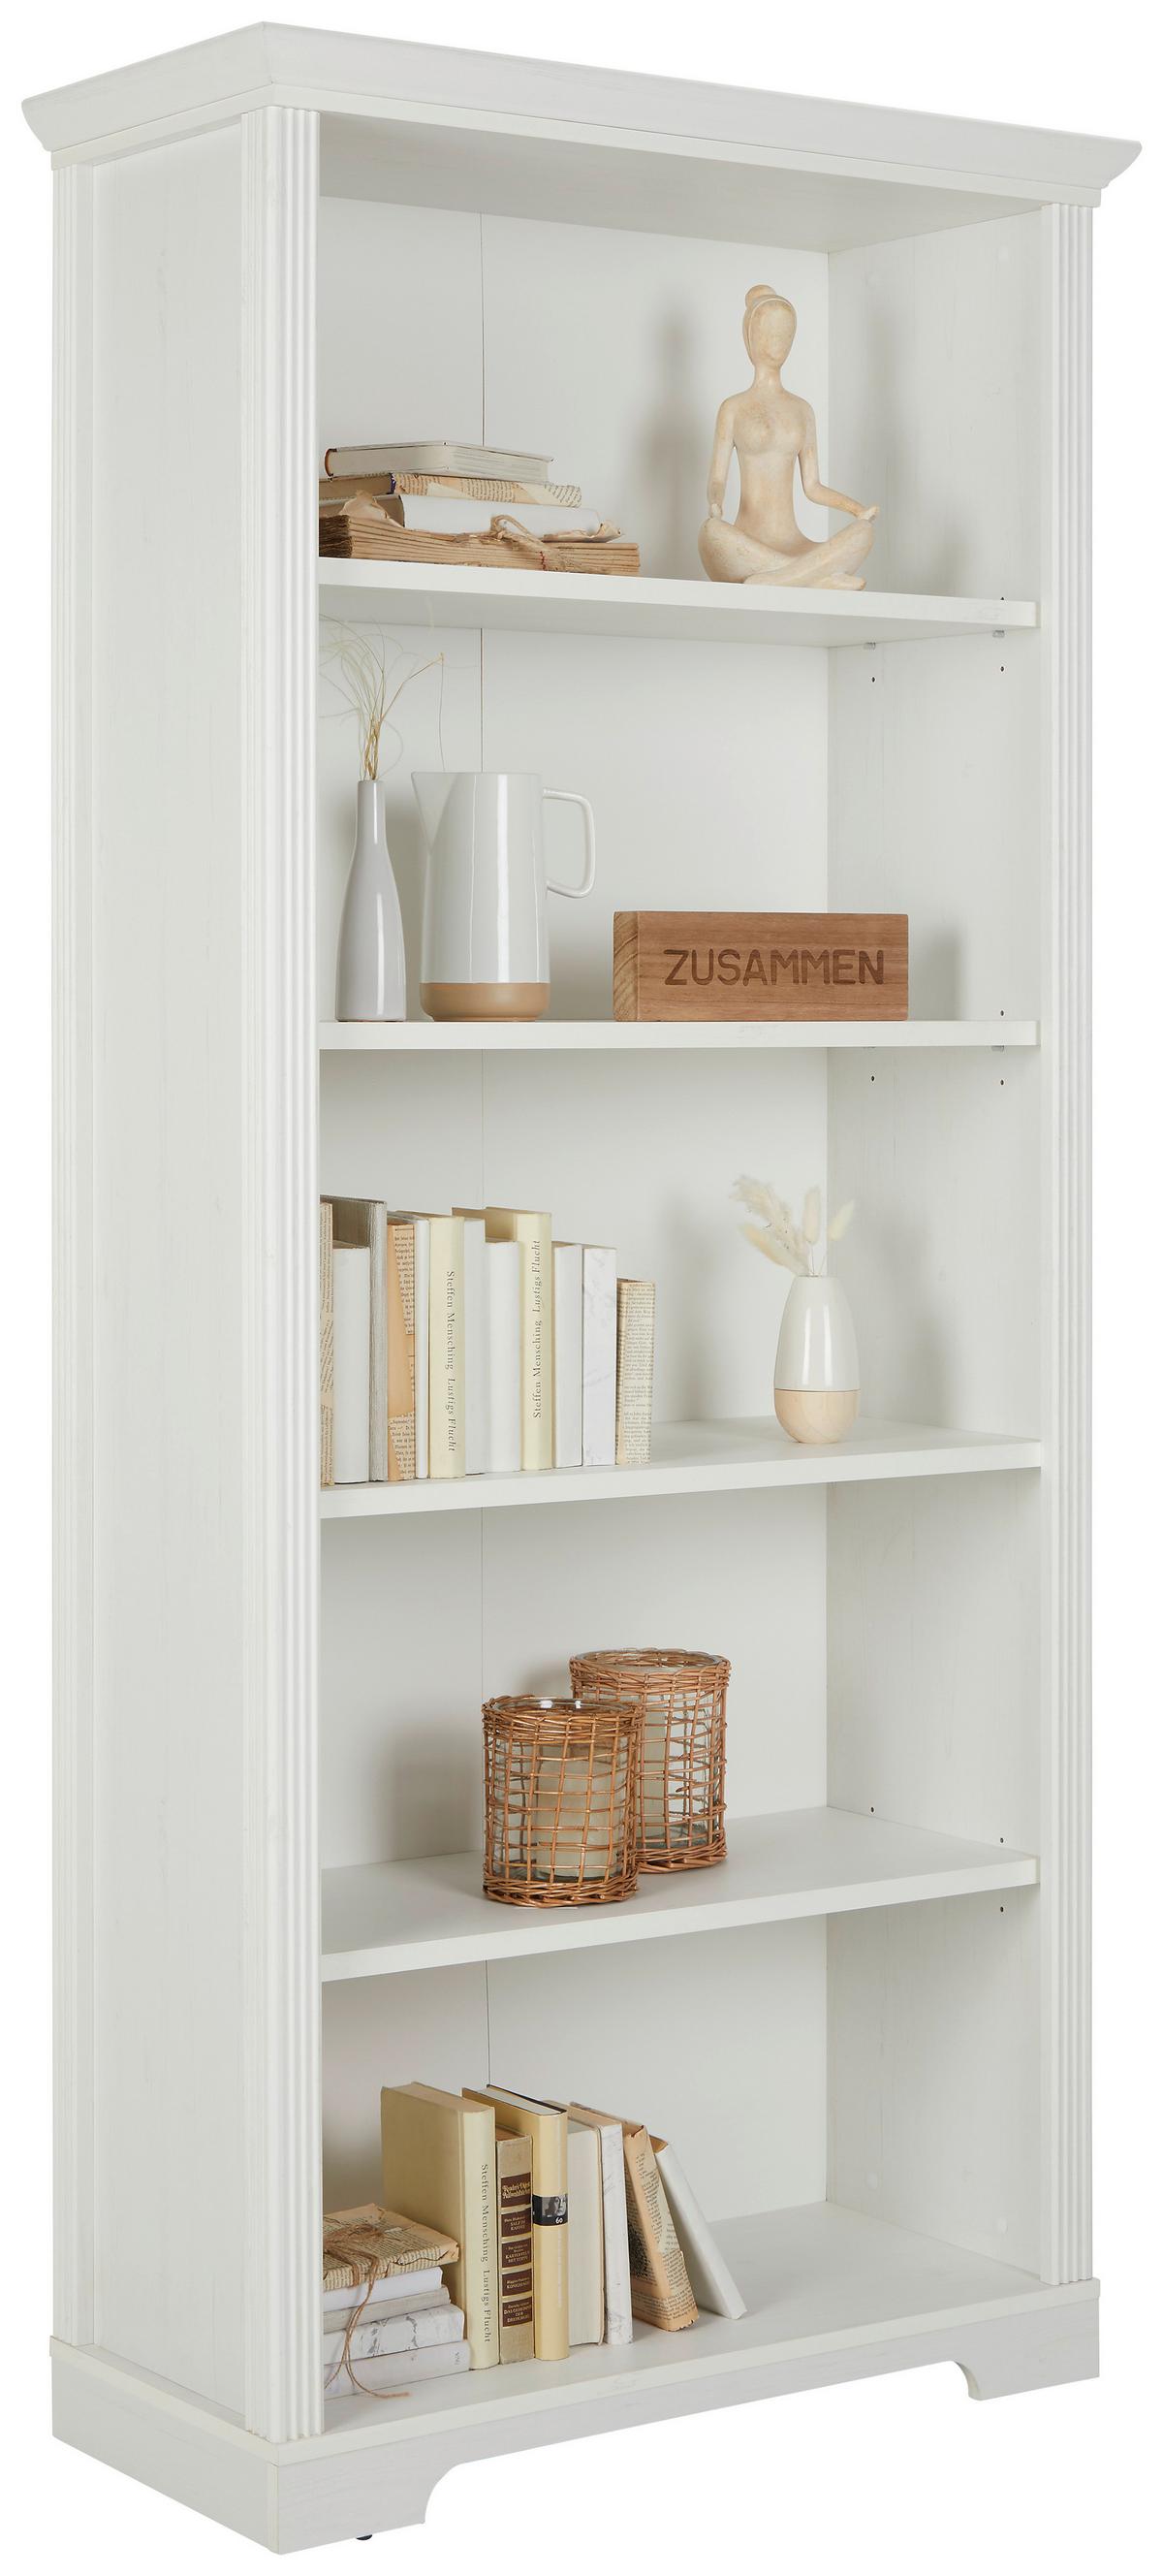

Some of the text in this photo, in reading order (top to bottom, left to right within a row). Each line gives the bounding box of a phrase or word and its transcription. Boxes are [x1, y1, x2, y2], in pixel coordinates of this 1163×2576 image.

[663, 948, 885, 987] ZUSAMMEN
[531, 1240, 541, 1273] Flucht
[446, 1271, 456, 1309] Steffen
[445, 1313, 456, 1370] Mensching
[532, 1320, 543, 1378] Mensching
[533, 1382, 542, 1418] Steffen
[448, 1418, 456, 1452] Flucht
[481, 2164, 489, 2201] Steffen
[481, 2205, 490, 2263] Mensching
